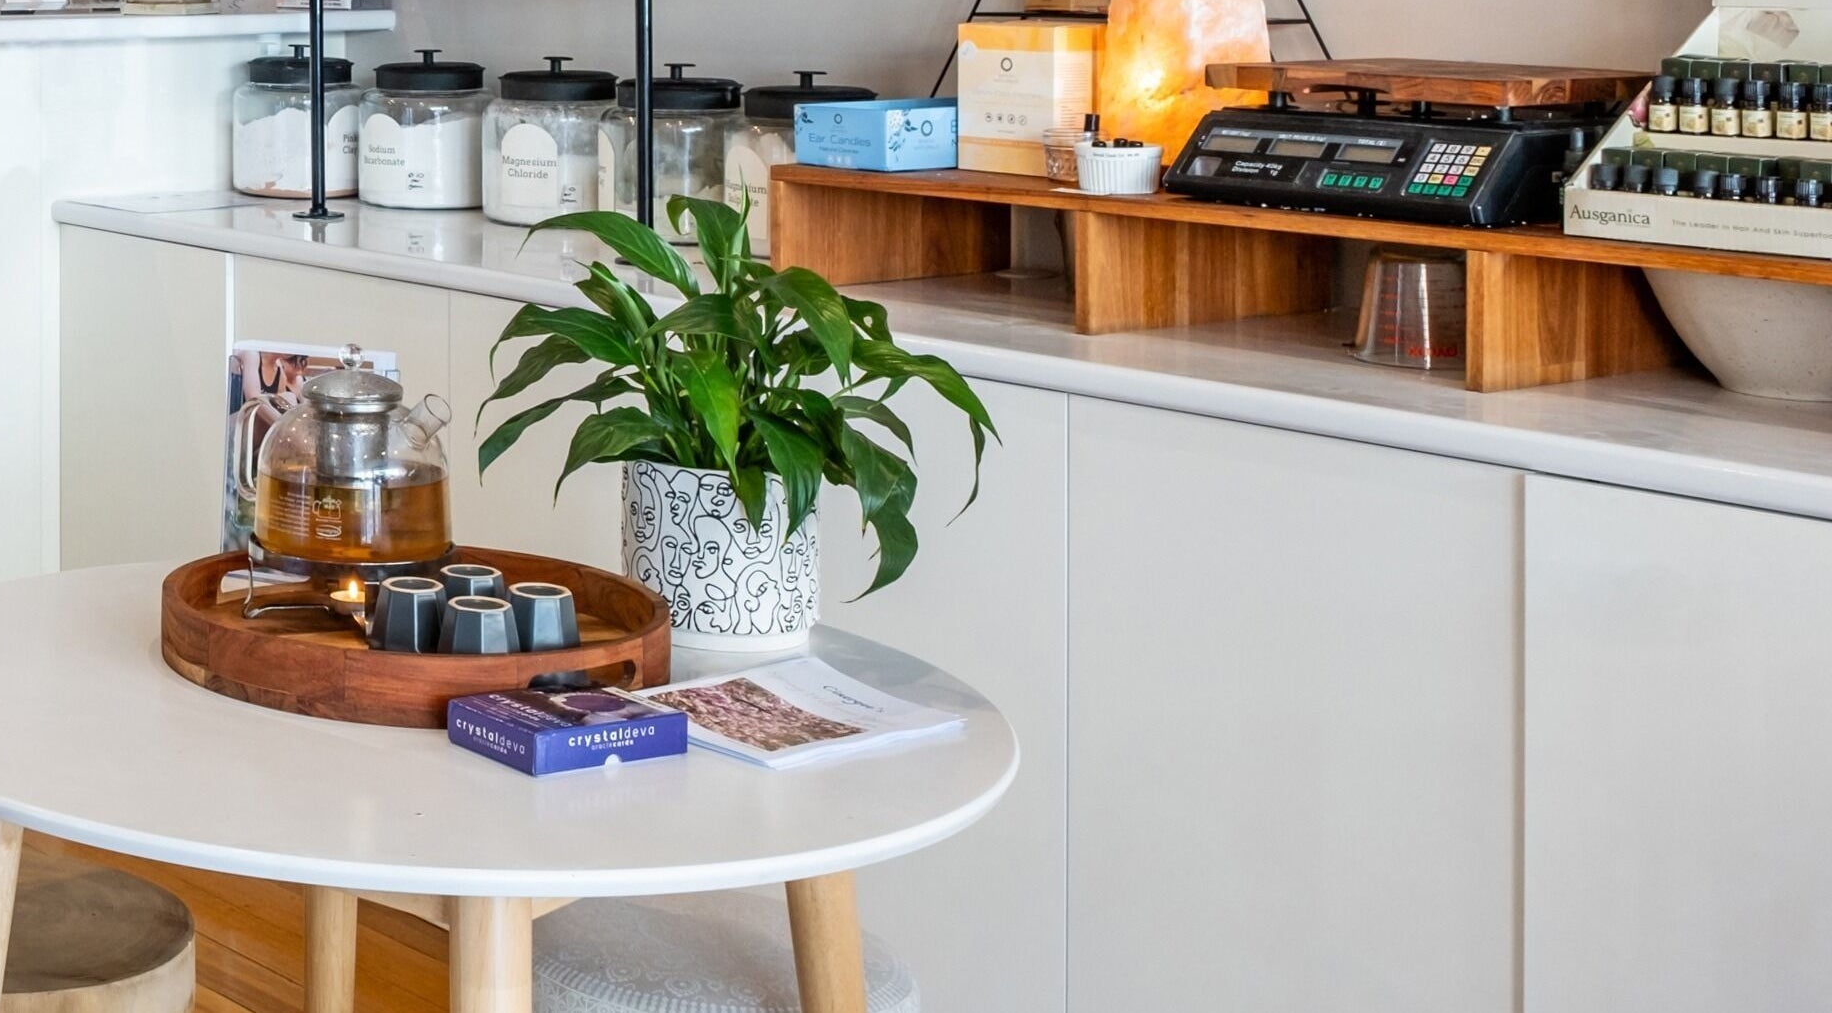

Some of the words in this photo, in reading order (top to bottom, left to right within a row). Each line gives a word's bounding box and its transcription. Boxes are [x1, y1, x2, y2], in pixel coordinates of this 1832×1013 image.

[808, 132, 826, 145] Ear
[830, 134, 872, 148] Candles
[368, 144, 396, 154] Sodium
[502, 155, 557, 168] Magnesium
[1235, 160, 1264, 171] Capacity
[507, 168, 549, 179] Chloride
[1570, 204, 1650, 225] Ausganica
[456, 717, 526, 756] crystaldeva
[568, 724, 656, 749] crystaldeva
